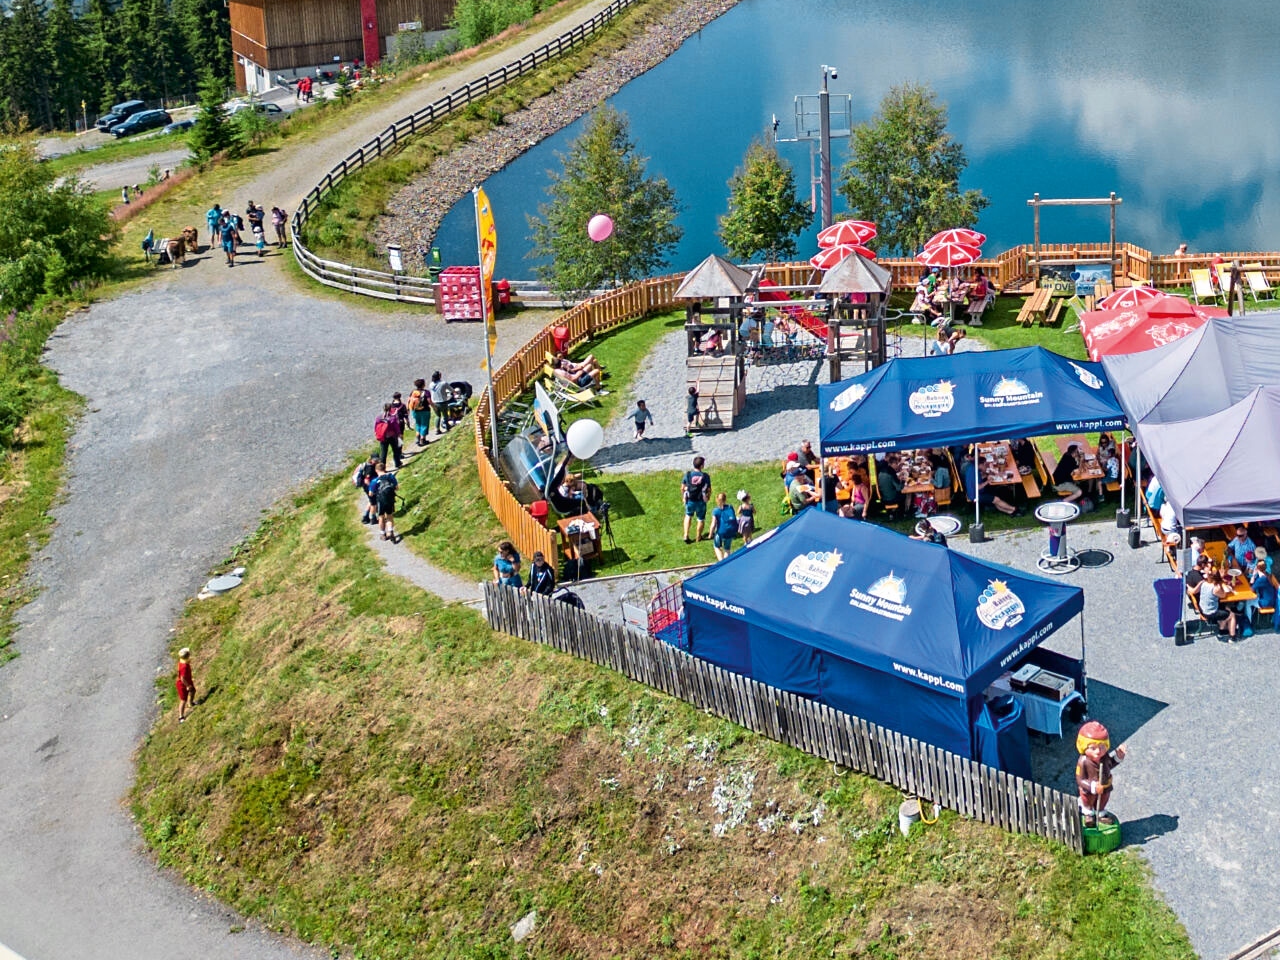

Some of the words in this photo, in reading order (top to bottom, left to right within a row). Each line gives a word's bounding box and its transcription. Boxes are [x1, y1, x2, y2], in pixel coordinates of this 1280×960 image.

[980, 396, 1004, 404] Sunny
[1005, 391, 1043, 401] Mountain
[1055, 419, 1122, 431] www.kappl.com
[824, 440, 896, 453] www.kappl.com
[685, 589, 745, 616] www.kappl.com
[849, 588, 876, 606] Sunny
[875, 597, 912, 616] Mountain
[1000, 622, 1053, 668] www.kappl.com
[892, 662, 965, 694] www.kappl.com
